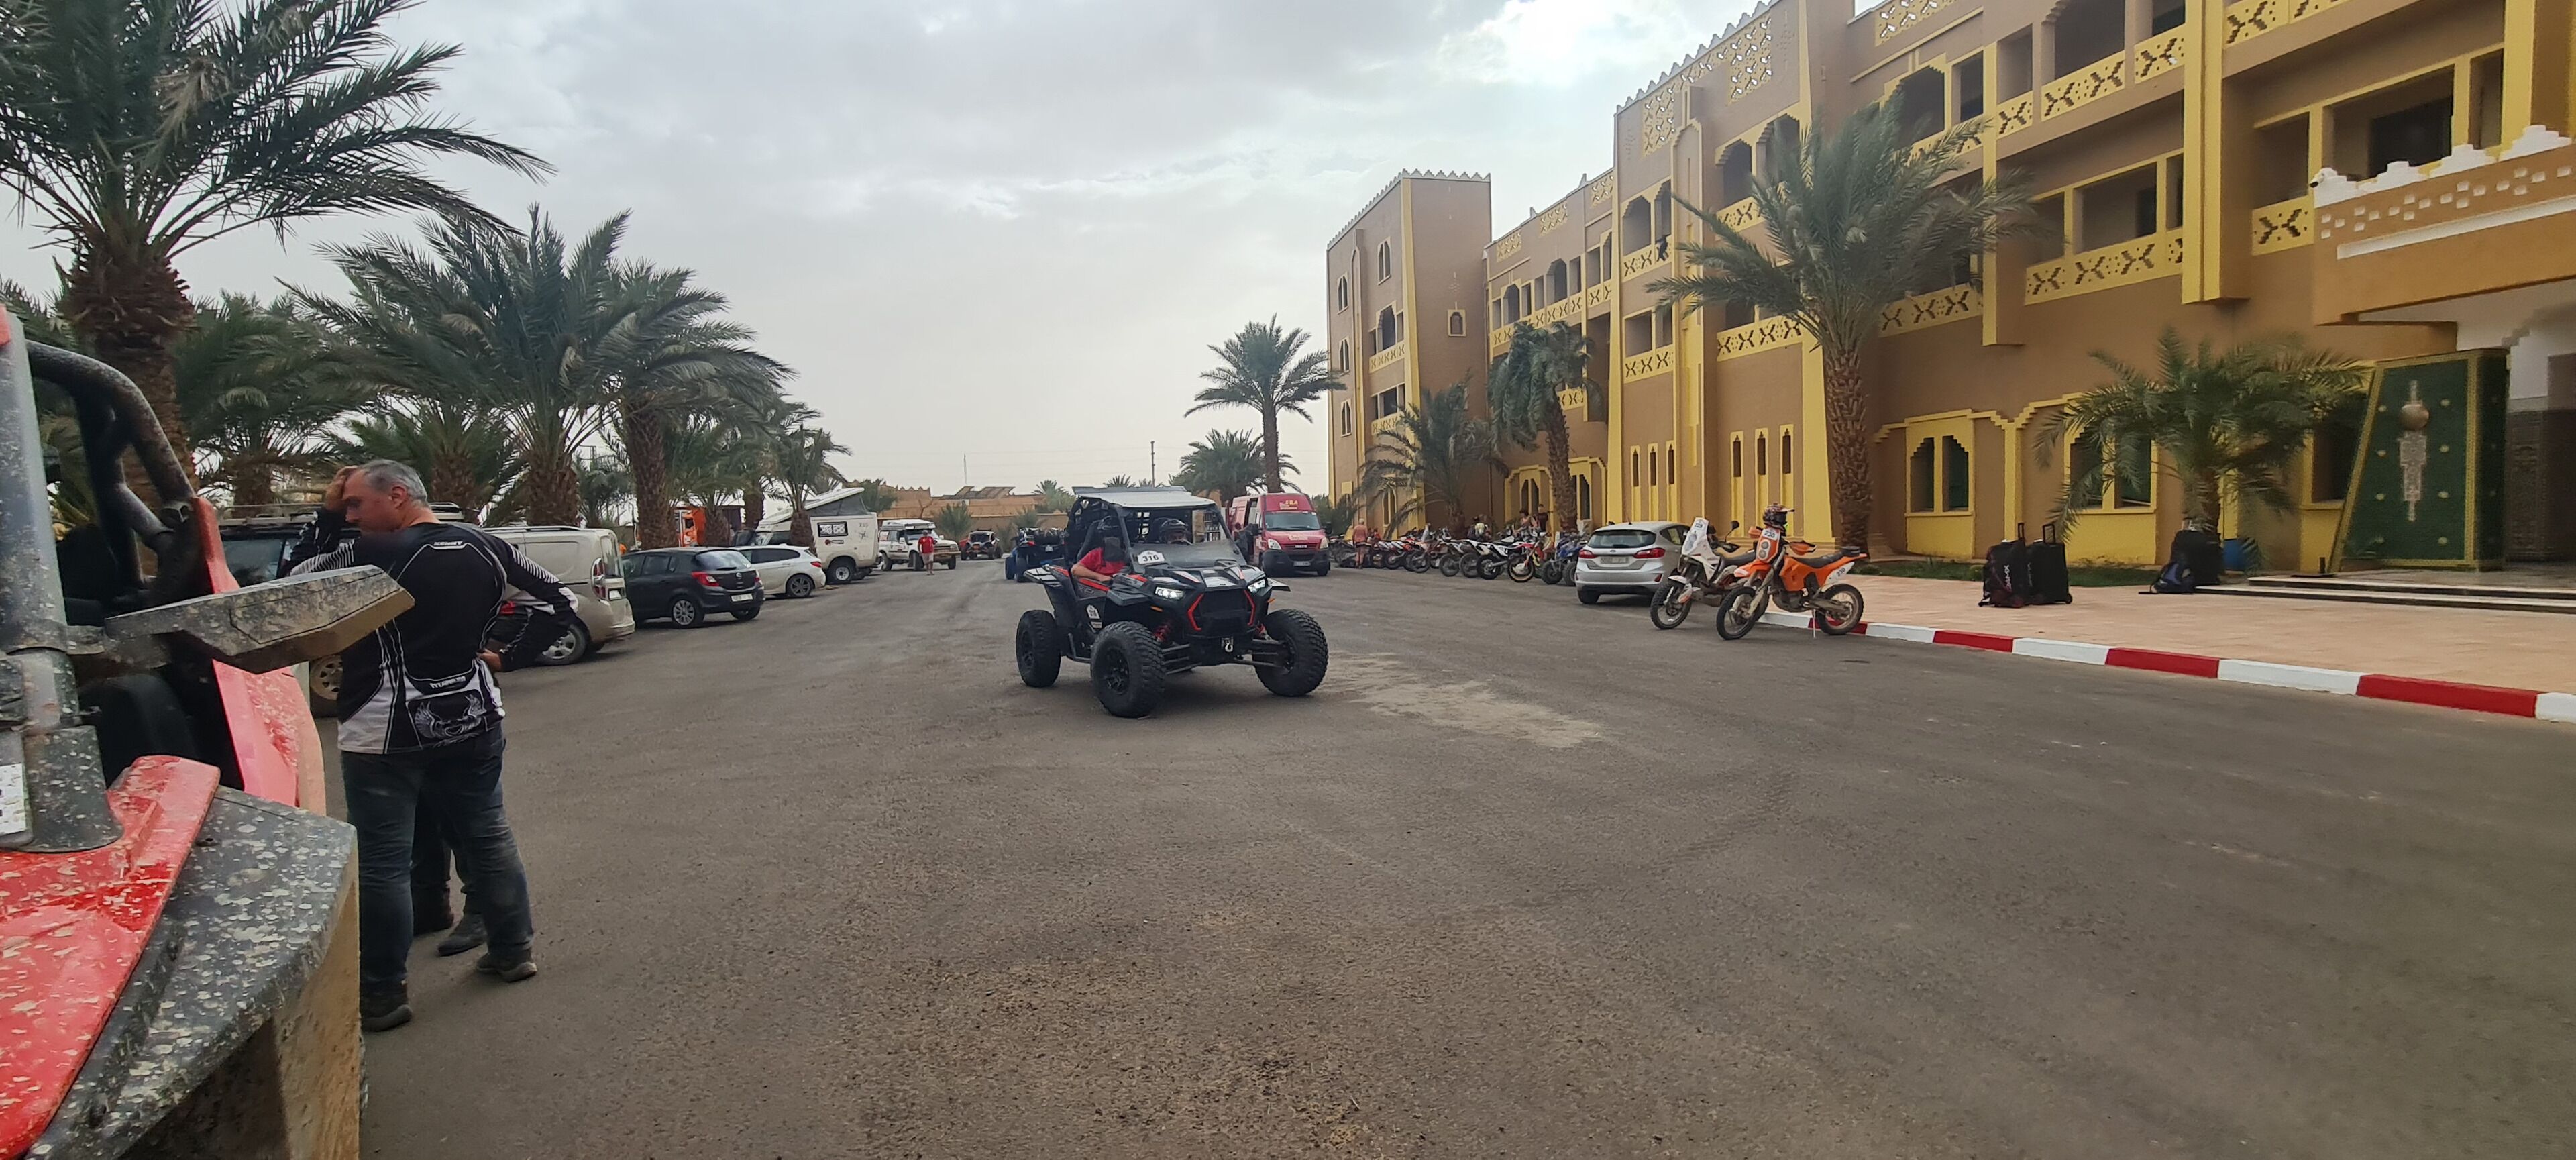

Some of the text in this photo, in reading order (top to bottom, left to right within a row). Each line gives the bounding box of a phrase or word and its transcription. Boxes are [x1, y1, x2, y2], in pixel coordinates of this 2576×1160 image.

[1764, 530, 1776, 538] 230
[1142, 554, 1159, 562] 316
[1836, 567, 1846, 577] 230
